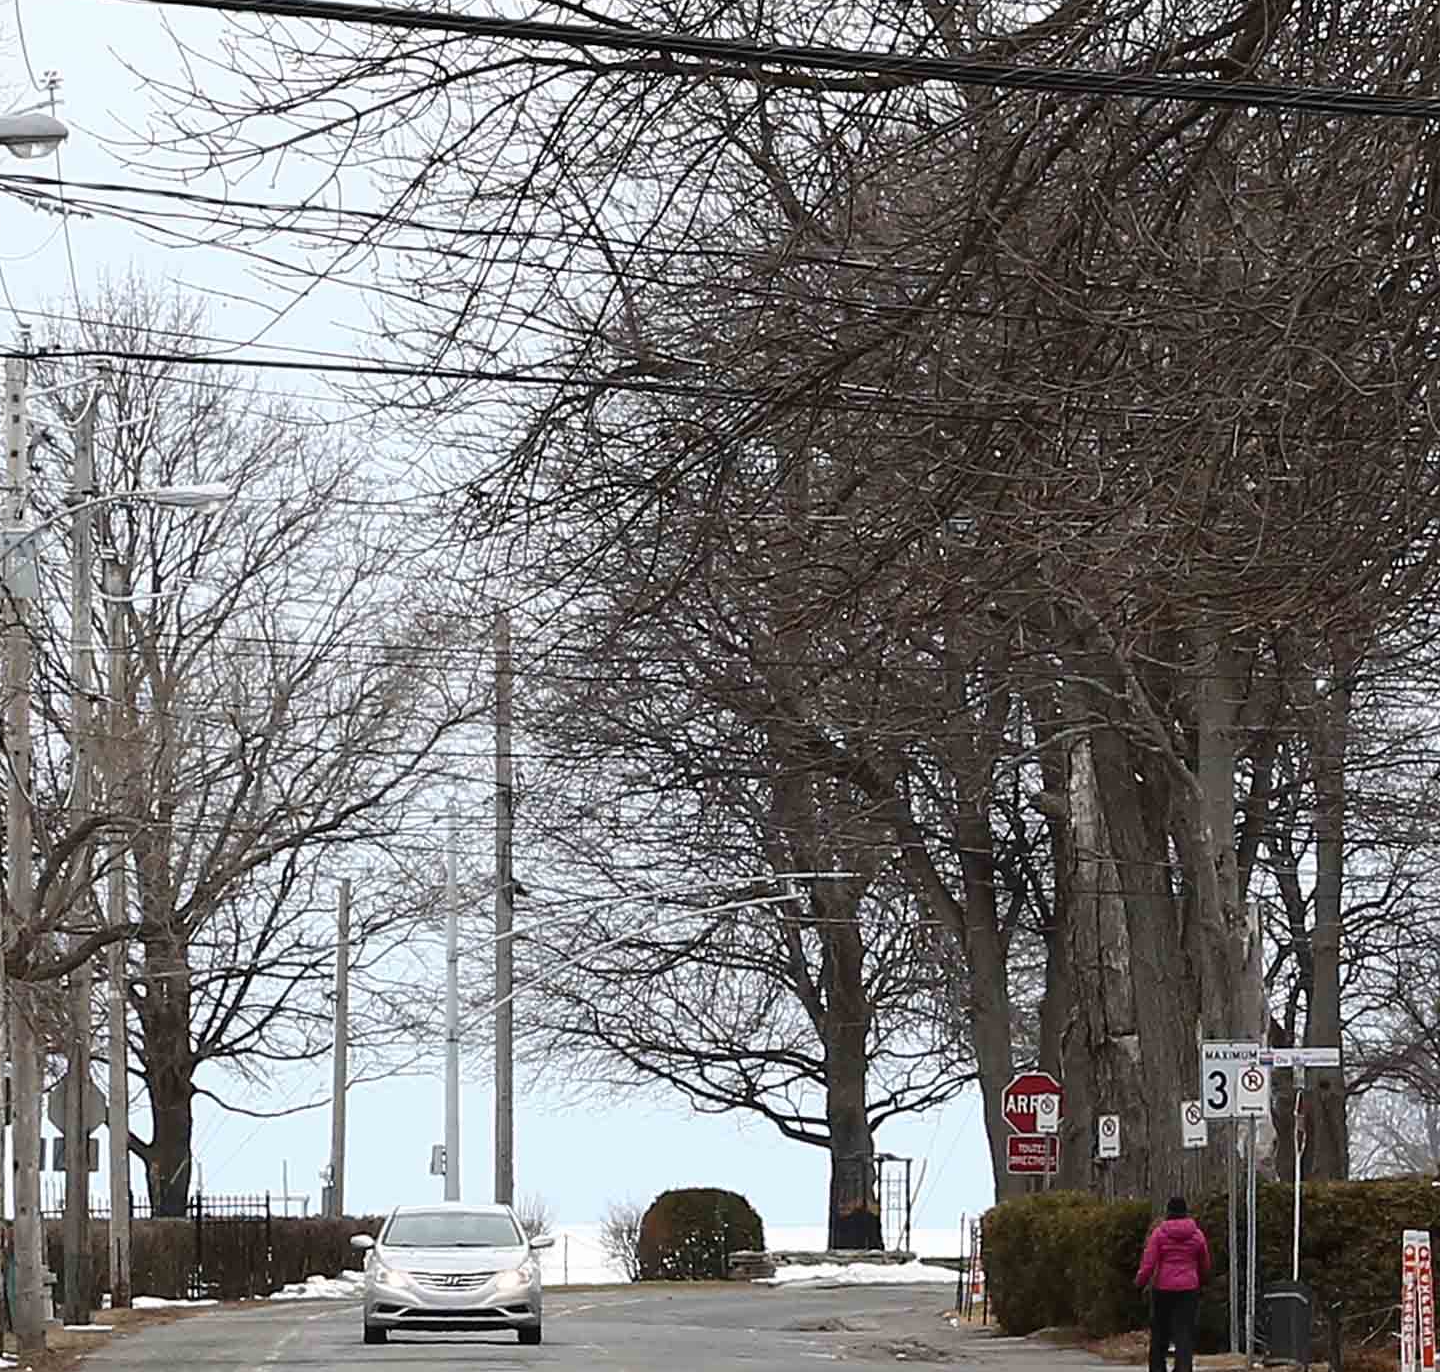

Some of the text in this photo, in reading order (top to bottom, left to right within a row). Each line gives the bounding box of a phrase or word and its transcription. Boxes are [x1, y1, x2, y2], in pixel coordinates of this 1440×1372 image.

[1205, 1051, 1257, 1060] MAXIMUM
[1207, 1071, 1228, 1109] 3
[1006, 1094, 1039, 1114] ARR
